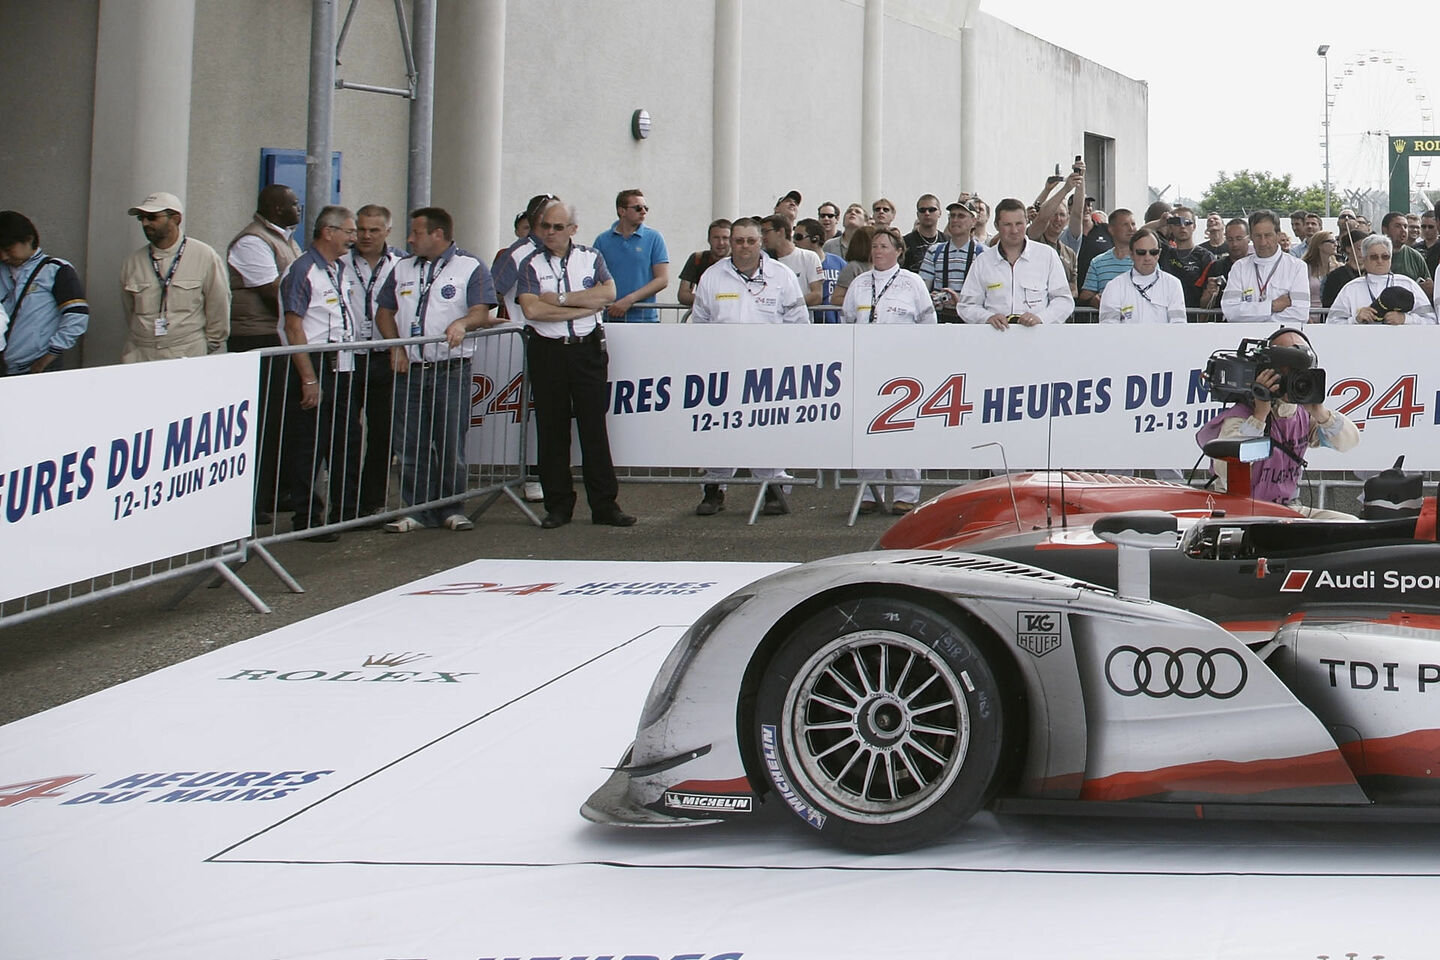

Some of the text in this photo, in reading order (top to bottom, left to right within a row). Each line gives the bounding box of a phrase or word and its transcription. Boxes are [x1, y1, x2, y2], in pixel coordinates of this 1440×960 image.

[684, 360, 843, 409] DU MANS
[866, 372, 974, 435] 24
[982, 376, 1112, 425] HEURES
[1123, 370, 1174, 411] DU
[1327, 373, 1425, 430] 24
[691, 402, 842, 433] 12-13 JUIN 2010
[1134, 412, 1187, 434] 12-13
[106, 432, 151, 490] DU
[163, 399, 252, 473] MANS
[112, 451, 248, 523] 12-13 JUIN 2010
[408, 581, 718, 596] 24 HEURES
[1315, 570, 1378, 590] Audi
[1024, 614, 1055, 632] TAG
[1020, 635, 1059, 654] HEUER
[219, 667, 480, 684] ROLEX
[1320, 657, 1399, 693] TDI
[762, 726, 806, 813] MICHELIN
[0, 770, 336, 808] 4 HEURES
[59, 787, 300, 805] DU MANS
[682, 796, 748, 808] MICHELIN
